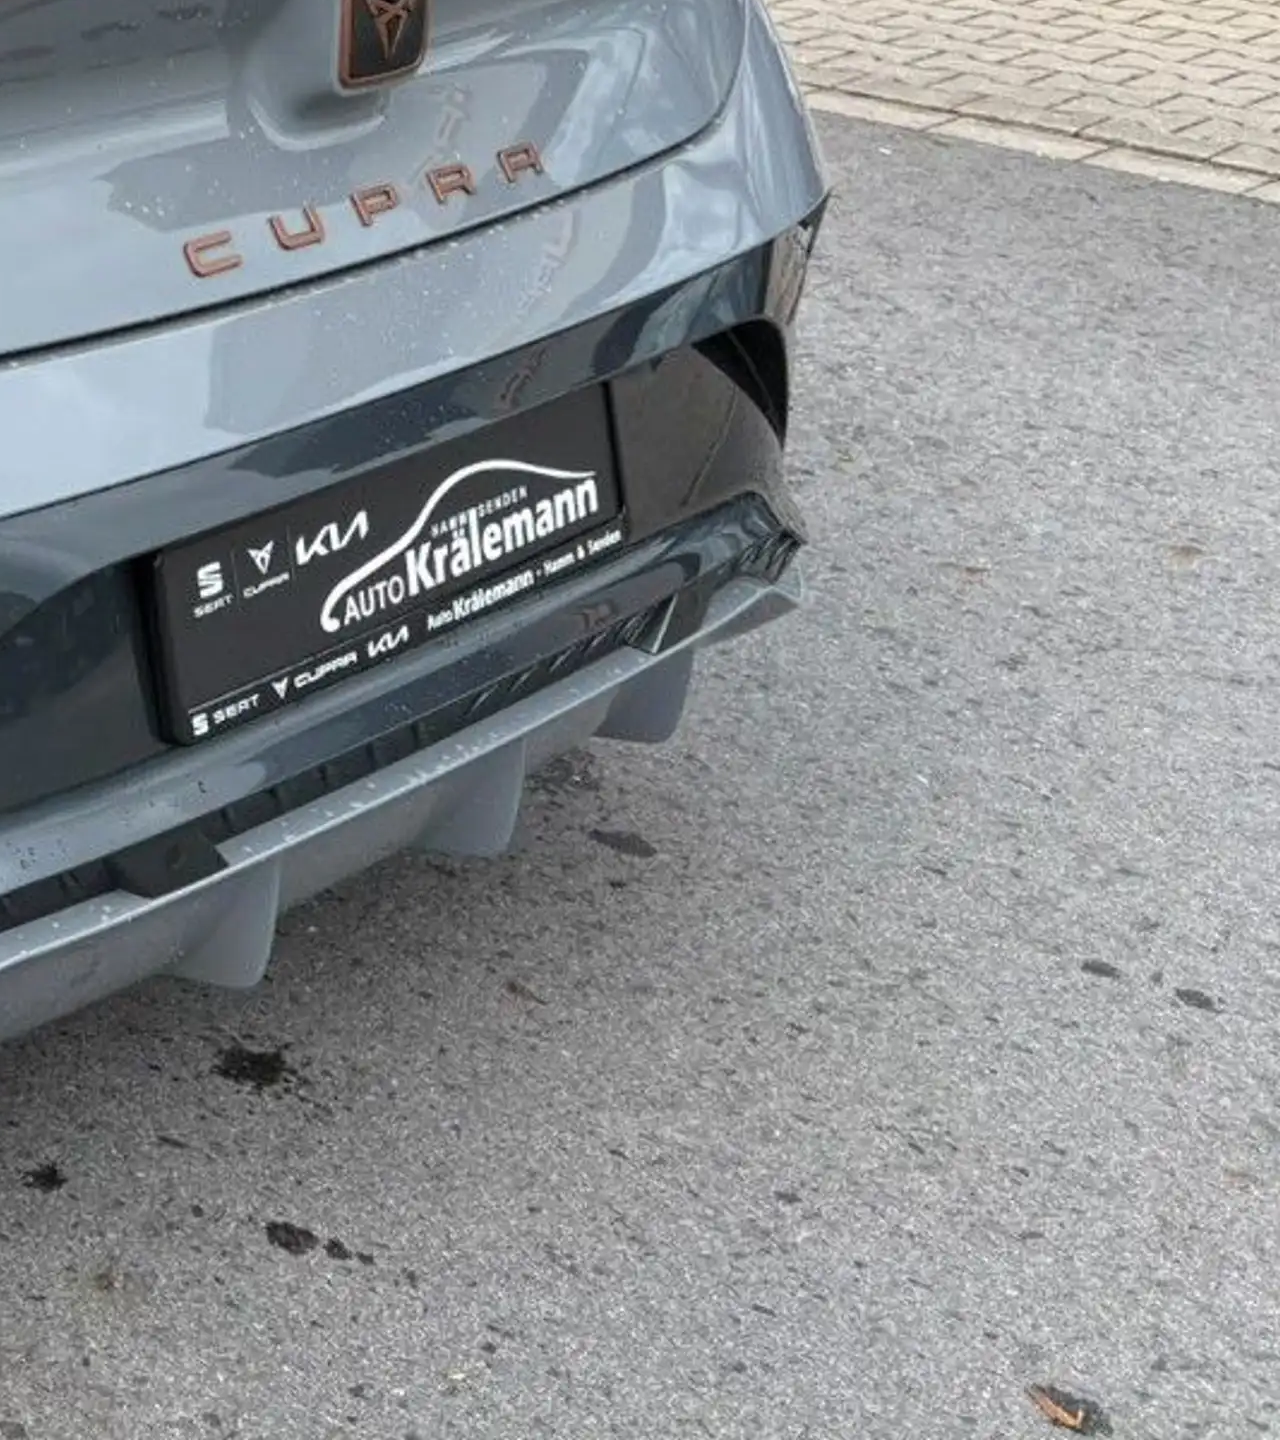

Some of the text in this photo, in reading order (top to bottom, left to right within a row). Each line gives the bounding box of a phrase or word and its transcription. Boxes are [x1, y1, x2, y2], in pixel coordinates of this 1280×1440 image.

[183, 141, 544, 278] CUPRA
[478, 485, 528, 519] SENDEN
[243, 571, 290, 599] CUPRA
[193, 593, 234, 618] SEAT
[213, 692, 260, 724] SEAT
[294, 650, 358, 689] CUPRA
[587, 530, 622, 555] Senden
